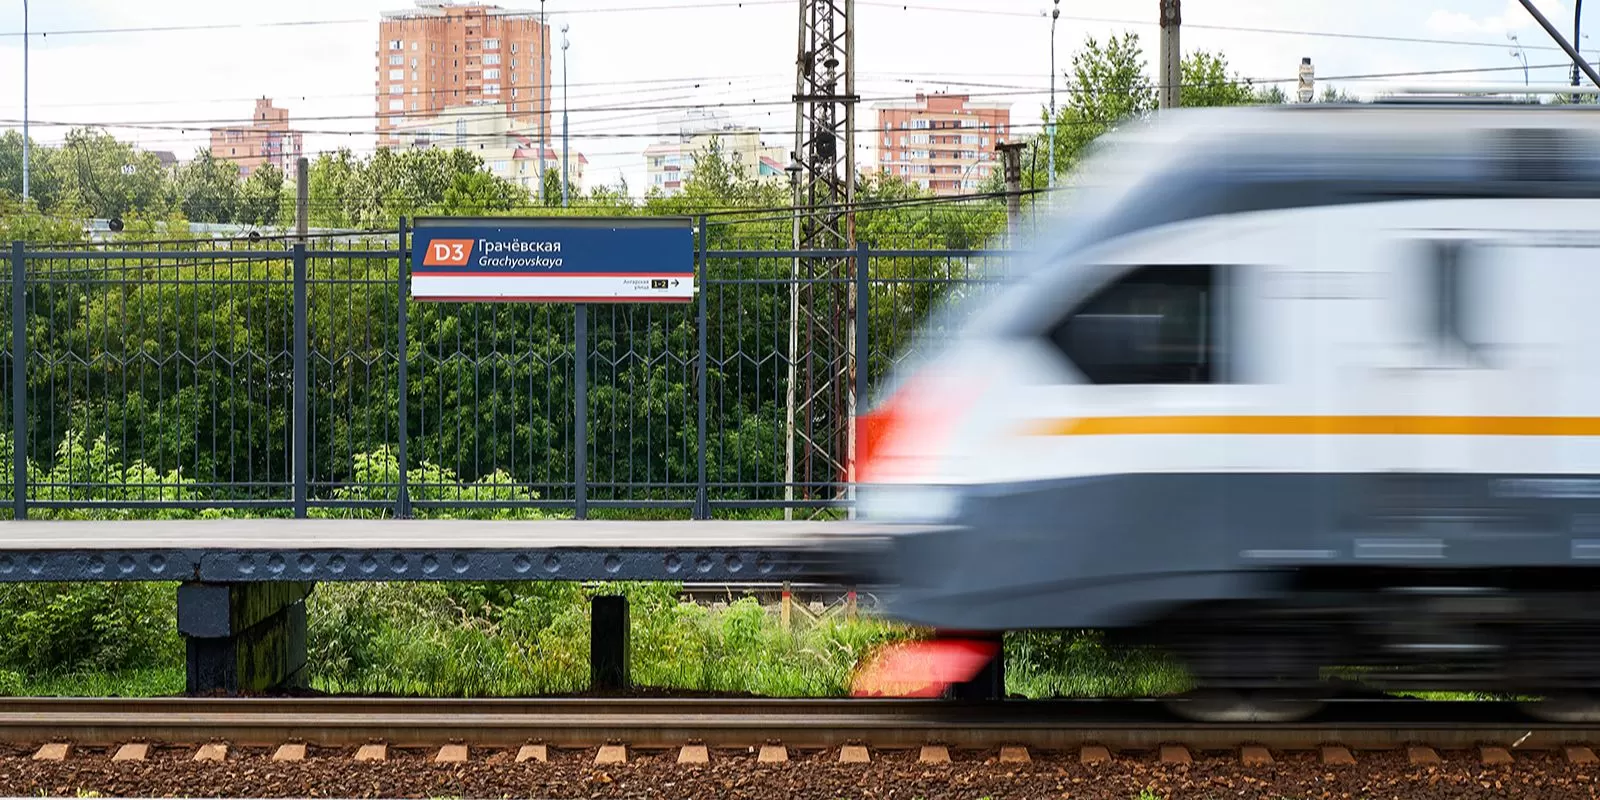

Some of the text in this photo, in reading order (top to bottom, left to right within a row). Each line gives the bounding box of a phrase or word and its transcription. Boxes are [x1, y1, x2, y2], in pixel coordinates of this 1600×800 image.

[433, 244, 464, 261] D3
[479, 238, 561, 255] Грачёвская
[479, 255, 563, 269] Grachyovskaya
